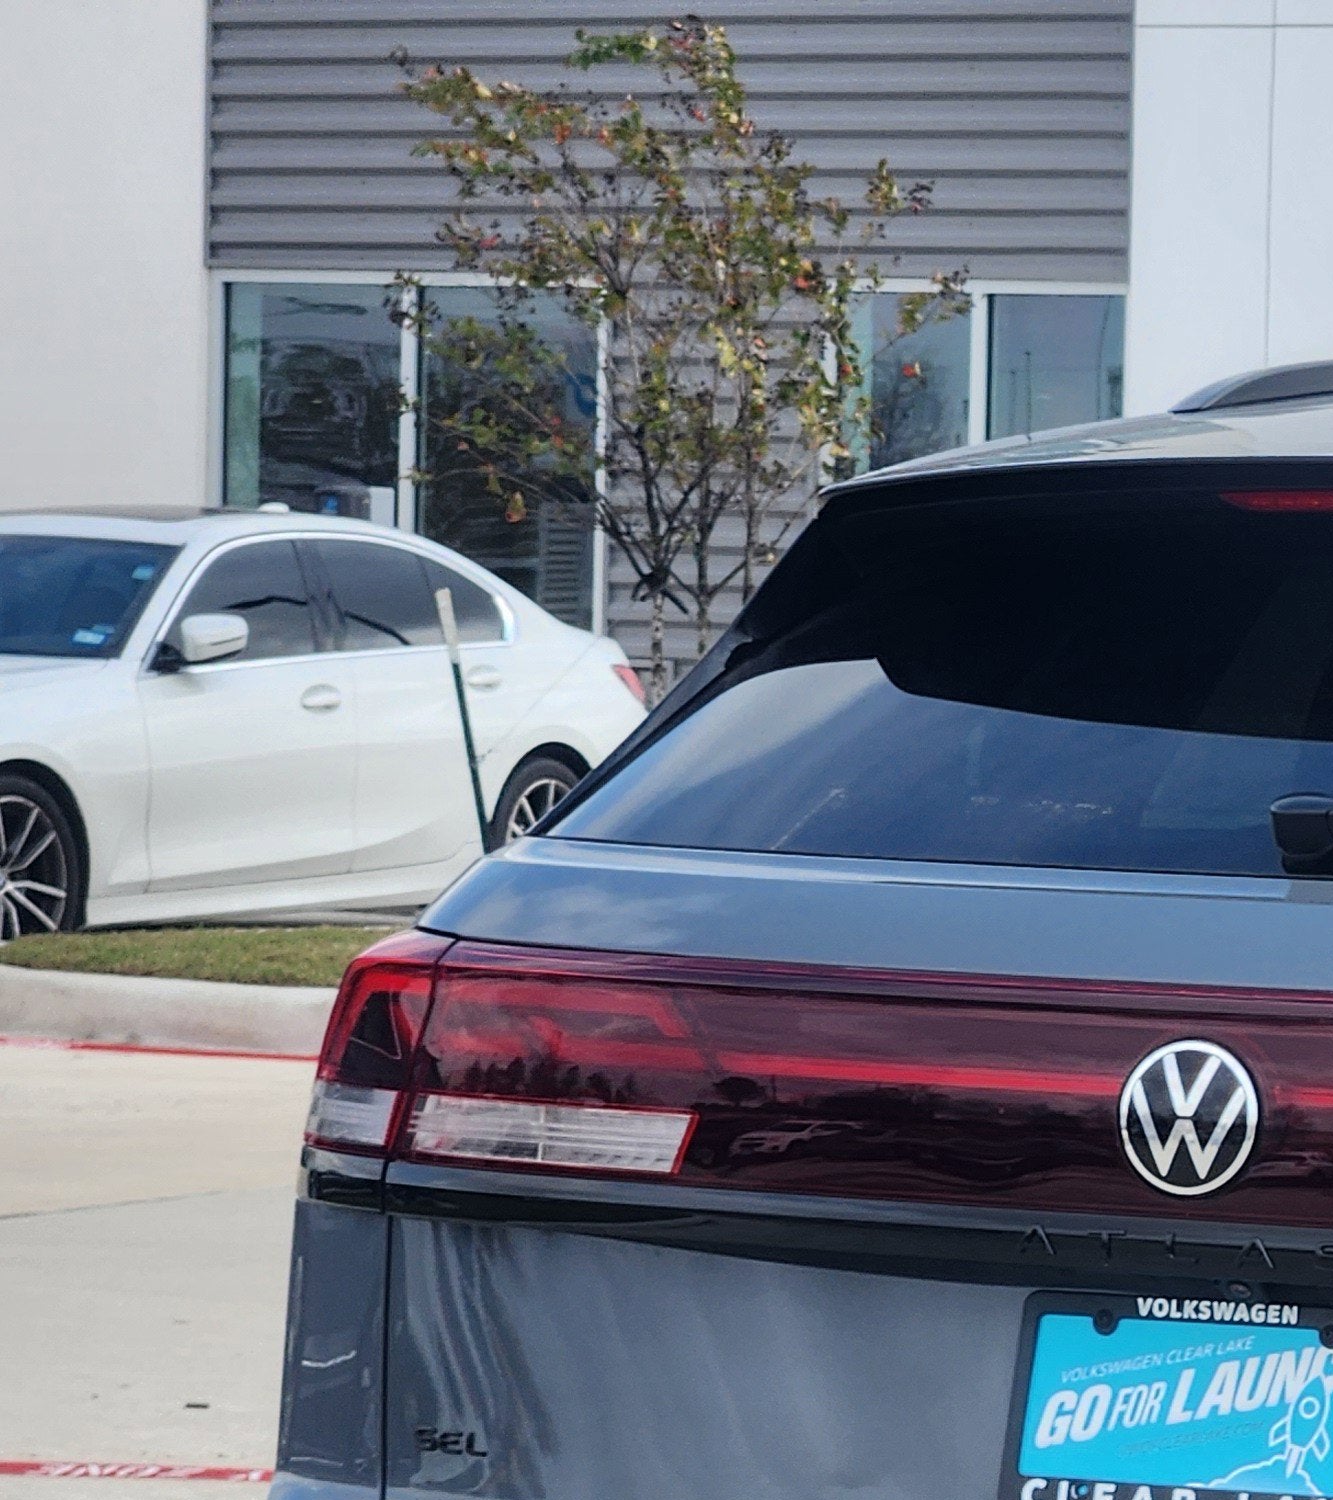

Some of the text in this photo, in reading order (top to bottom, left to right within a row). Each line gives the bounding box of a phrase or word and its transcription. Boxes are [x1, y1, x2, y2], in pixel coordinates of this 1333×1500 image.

[1126, 1046, 1252, 1188] VW
[1136, 1297, 1299, 1326] VOLKSWAGEN
[1061, 1335, 1256, 1383] VOLKSWAGEN CLEAR LAKE
[1035, 1384, 1113, 1448] GO
[1107, 1381, 1168, 1431] FOR
[415, 1427, 488, 1457] SEL
